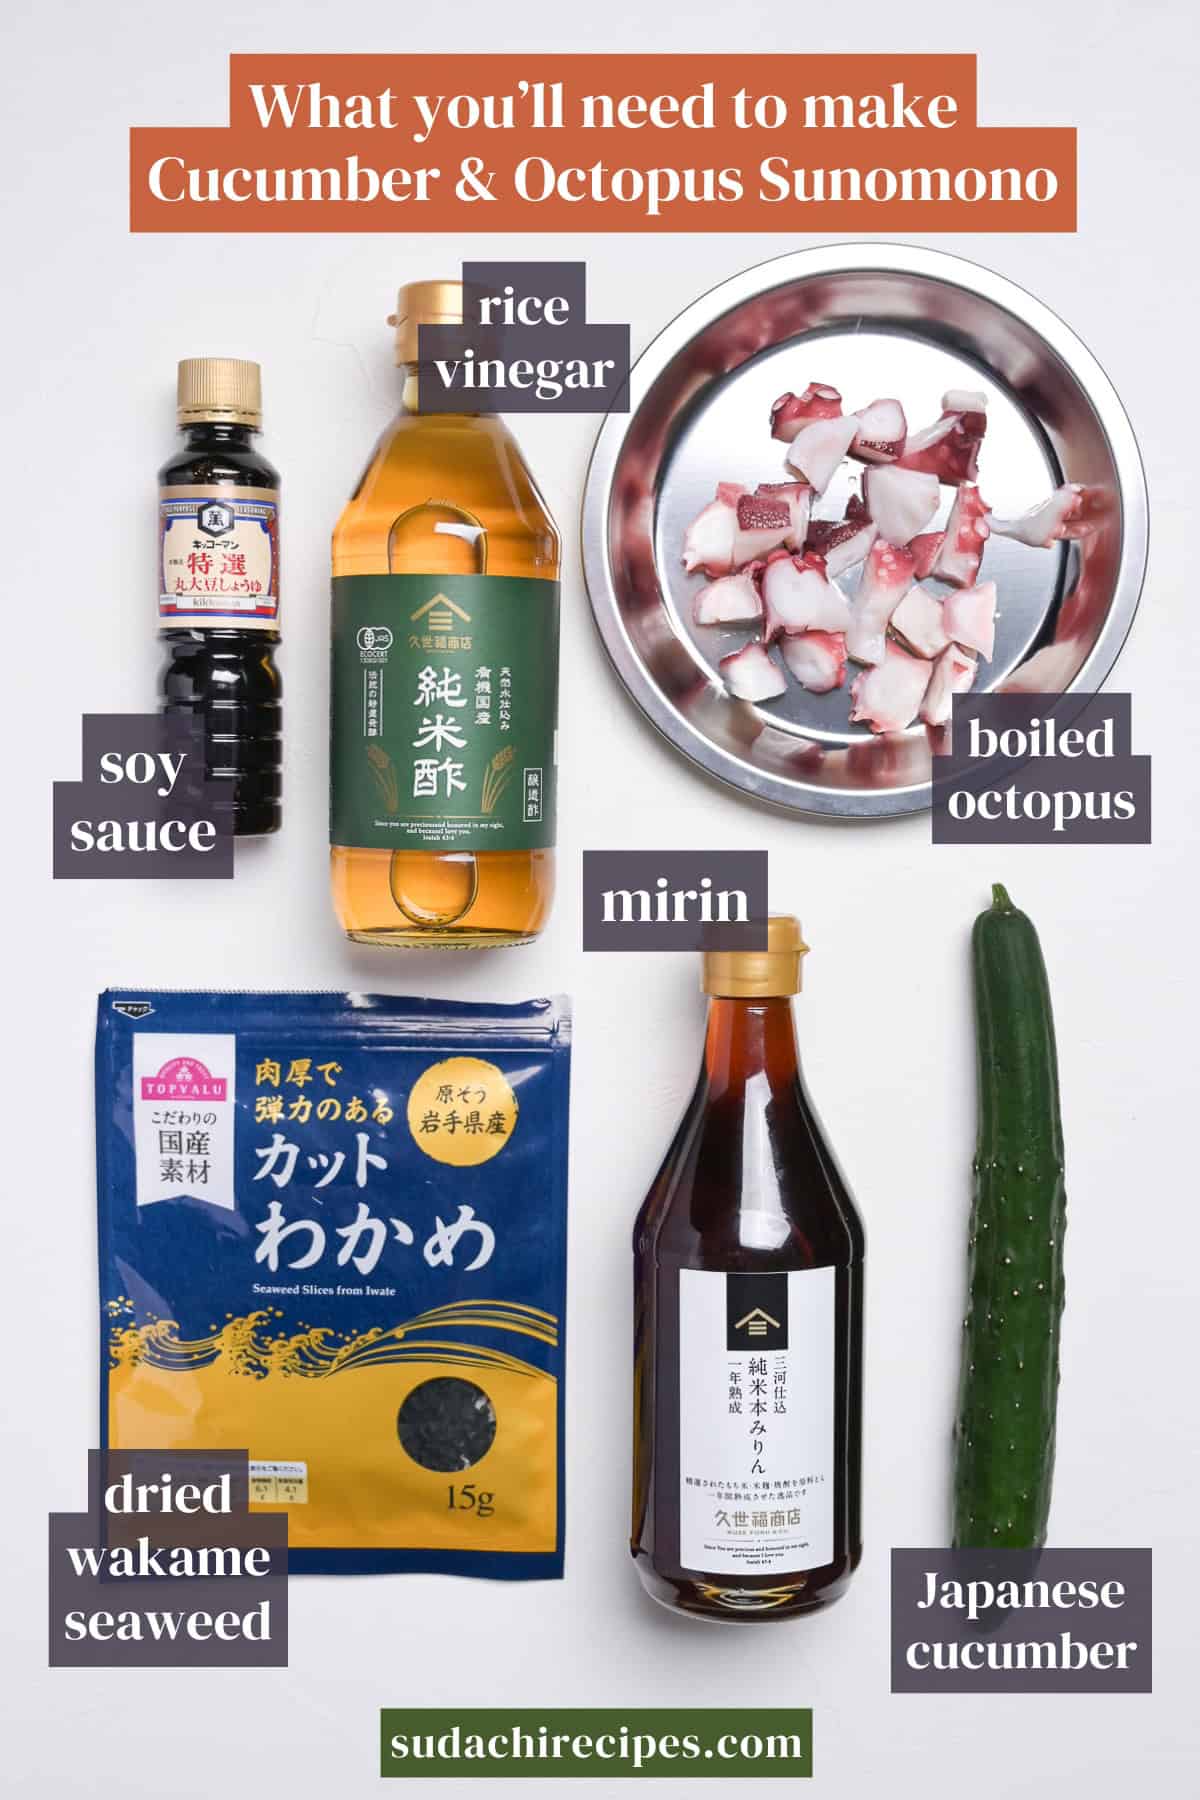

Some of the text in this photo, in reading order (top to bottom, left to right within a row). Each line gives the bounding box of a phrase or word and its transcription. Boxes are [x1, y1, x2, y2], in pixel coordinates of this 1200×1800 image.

[192, 540, 239, 550] キッコーマン
[187, 552, 247, 575] 特選
[176, 577, 262, 592] 丸大豆しょうゆ
[409, 635, 472, 649] 久世福商店
[474, 666, 492, 725] 有機国産
[499, 667, 512, 731] 天然水仕込み
[412, 665, 468, 798] 純米酢
[527, 774, 540, 817] 醸造酢
[255, 1058, 343, 1087] 肉厚で
[146, 1083, 222, 1096] TOPVALU
[435, 1084, 488, 1104] 原そう
[152, 1111, 217, 1125] こだわりの
[255, 1095, 394, 1125] 弾力のある
[419, 1110, 507, 1135] 岩手県産
[159, 1130, 211, 1155] 国産
[159, 1158, 211, 1184] 素材
[252, 1132, 388, 1188] カット
[255, 1201, 496, 1276] わかめ
[252, 1283, 397, 1297] Seaweed Slices from Iwate
[727, 1361, 743, 1415] 一年熟成
[773, 1356, 787, 1415] 三河仕込
[748, 1357, 768, 1475] 純米本みりん
[448, 1484, 495, 1518] 15g
[714, 1508, 801, 1528] 久世福商店
